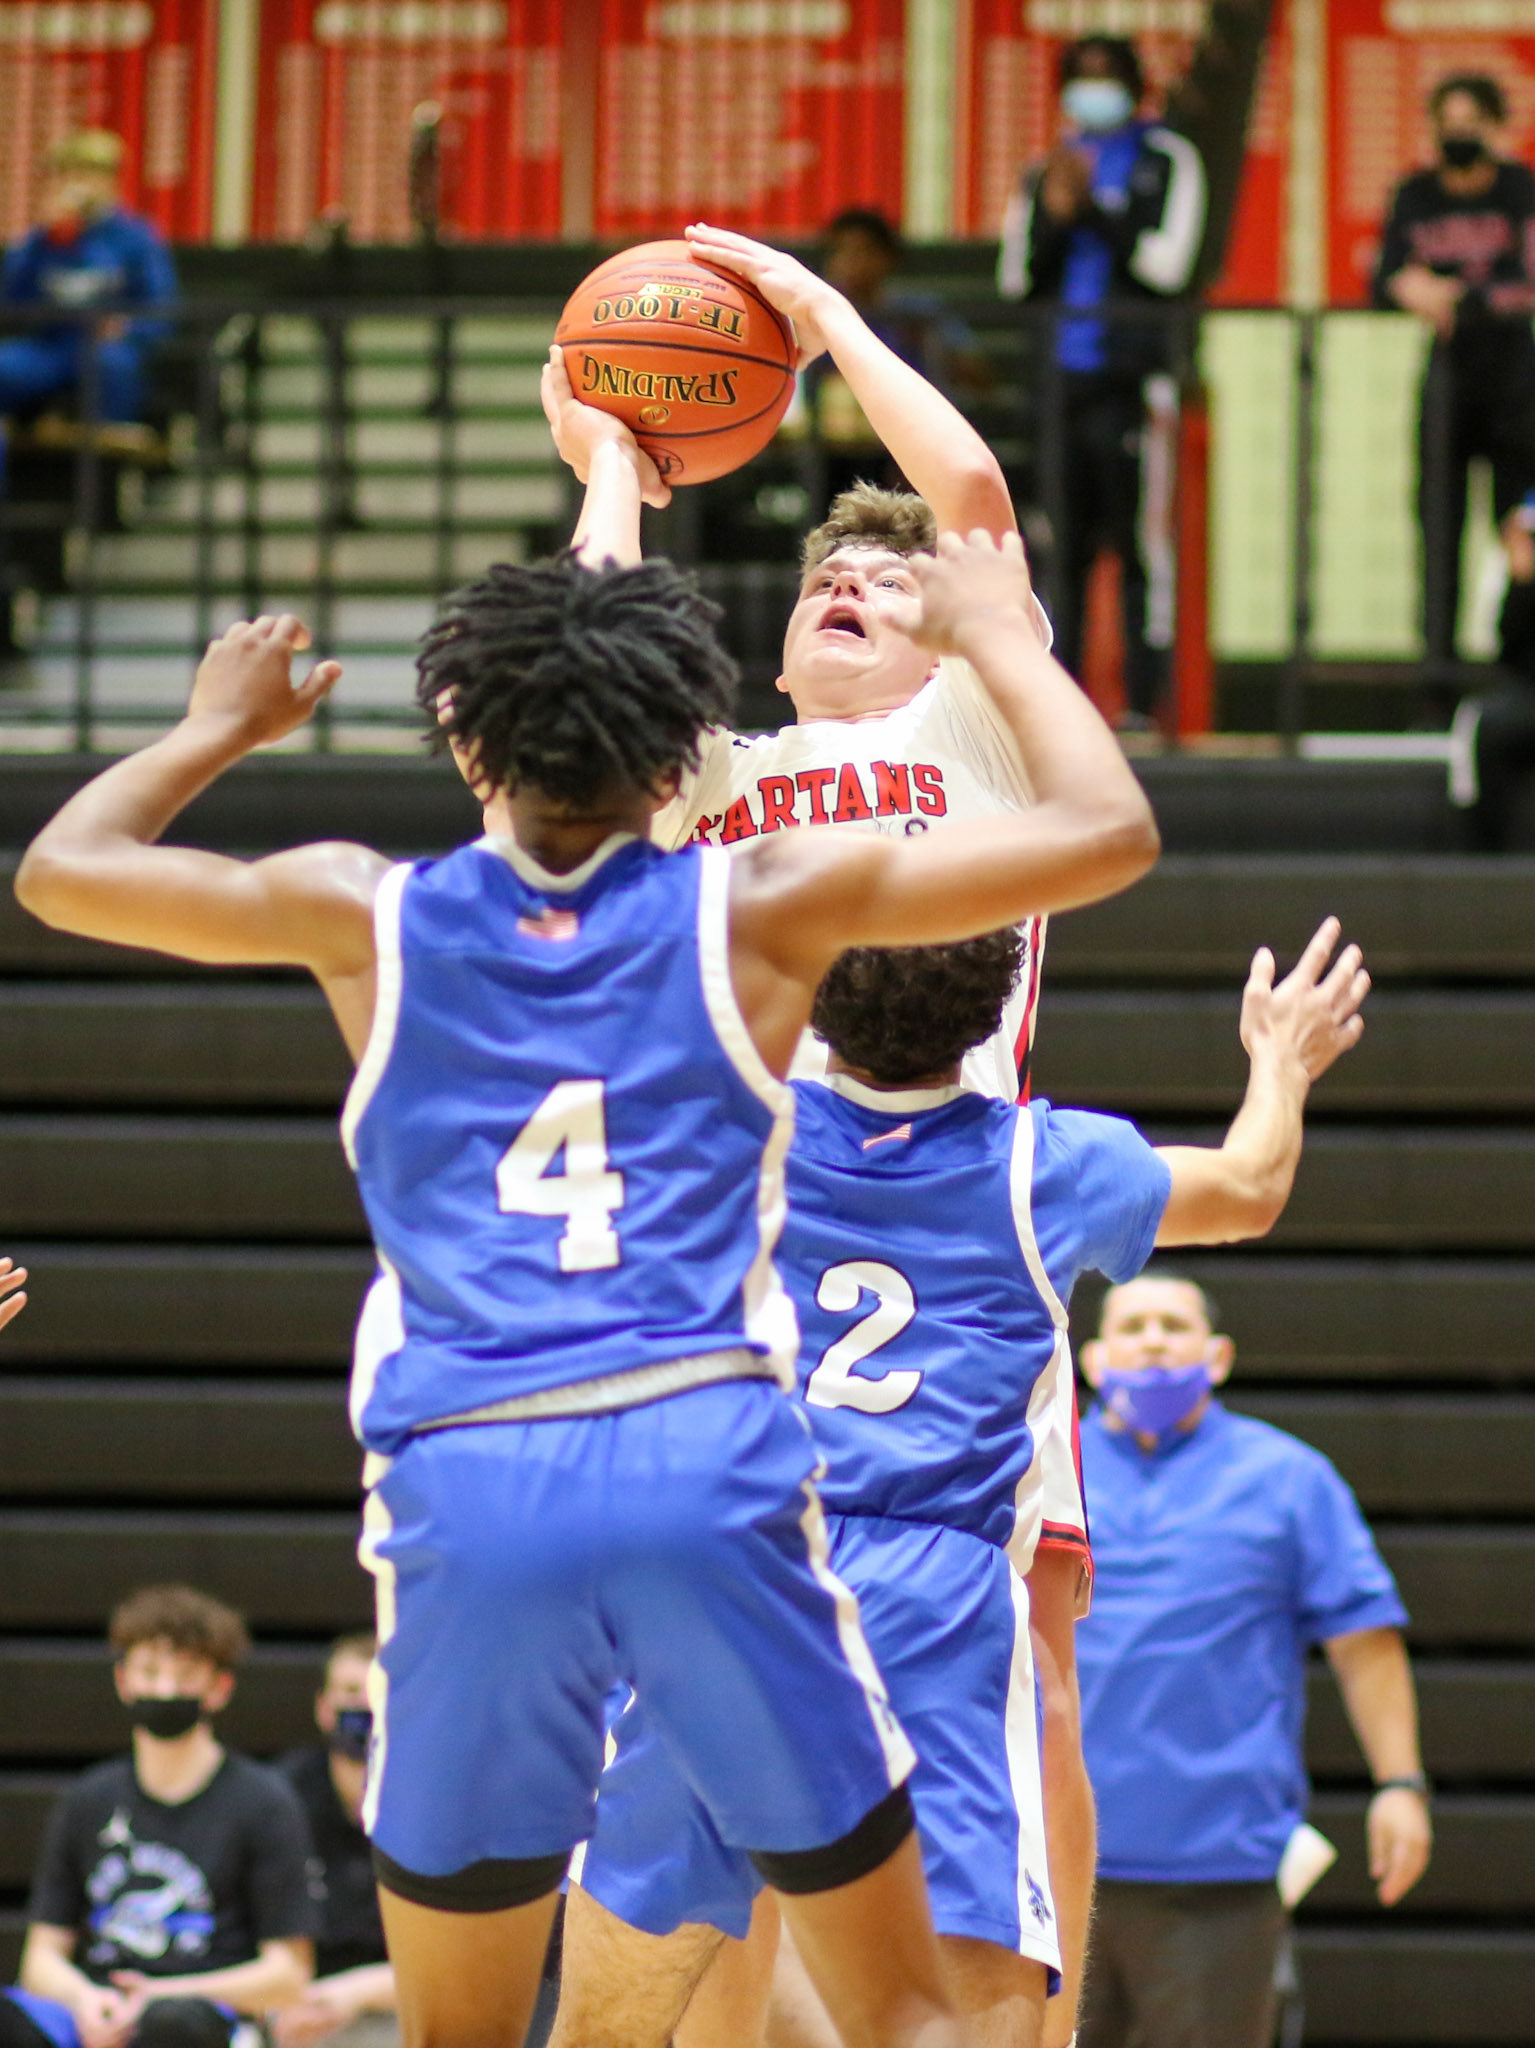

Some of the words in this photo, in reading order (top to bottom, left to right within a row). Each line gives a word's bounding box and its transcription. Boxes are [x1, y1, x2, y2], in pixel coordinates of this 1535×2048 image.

[592, 295, 743, 338] TF-1000
[644, 284, 701, 299] LEGA
[582, 354, 739, 406] SPALDING
[686, 760, 948, 847] ARTANS
[496, 1080, 624, 1273] 4
[803, 1257, 925, 1415] 2
